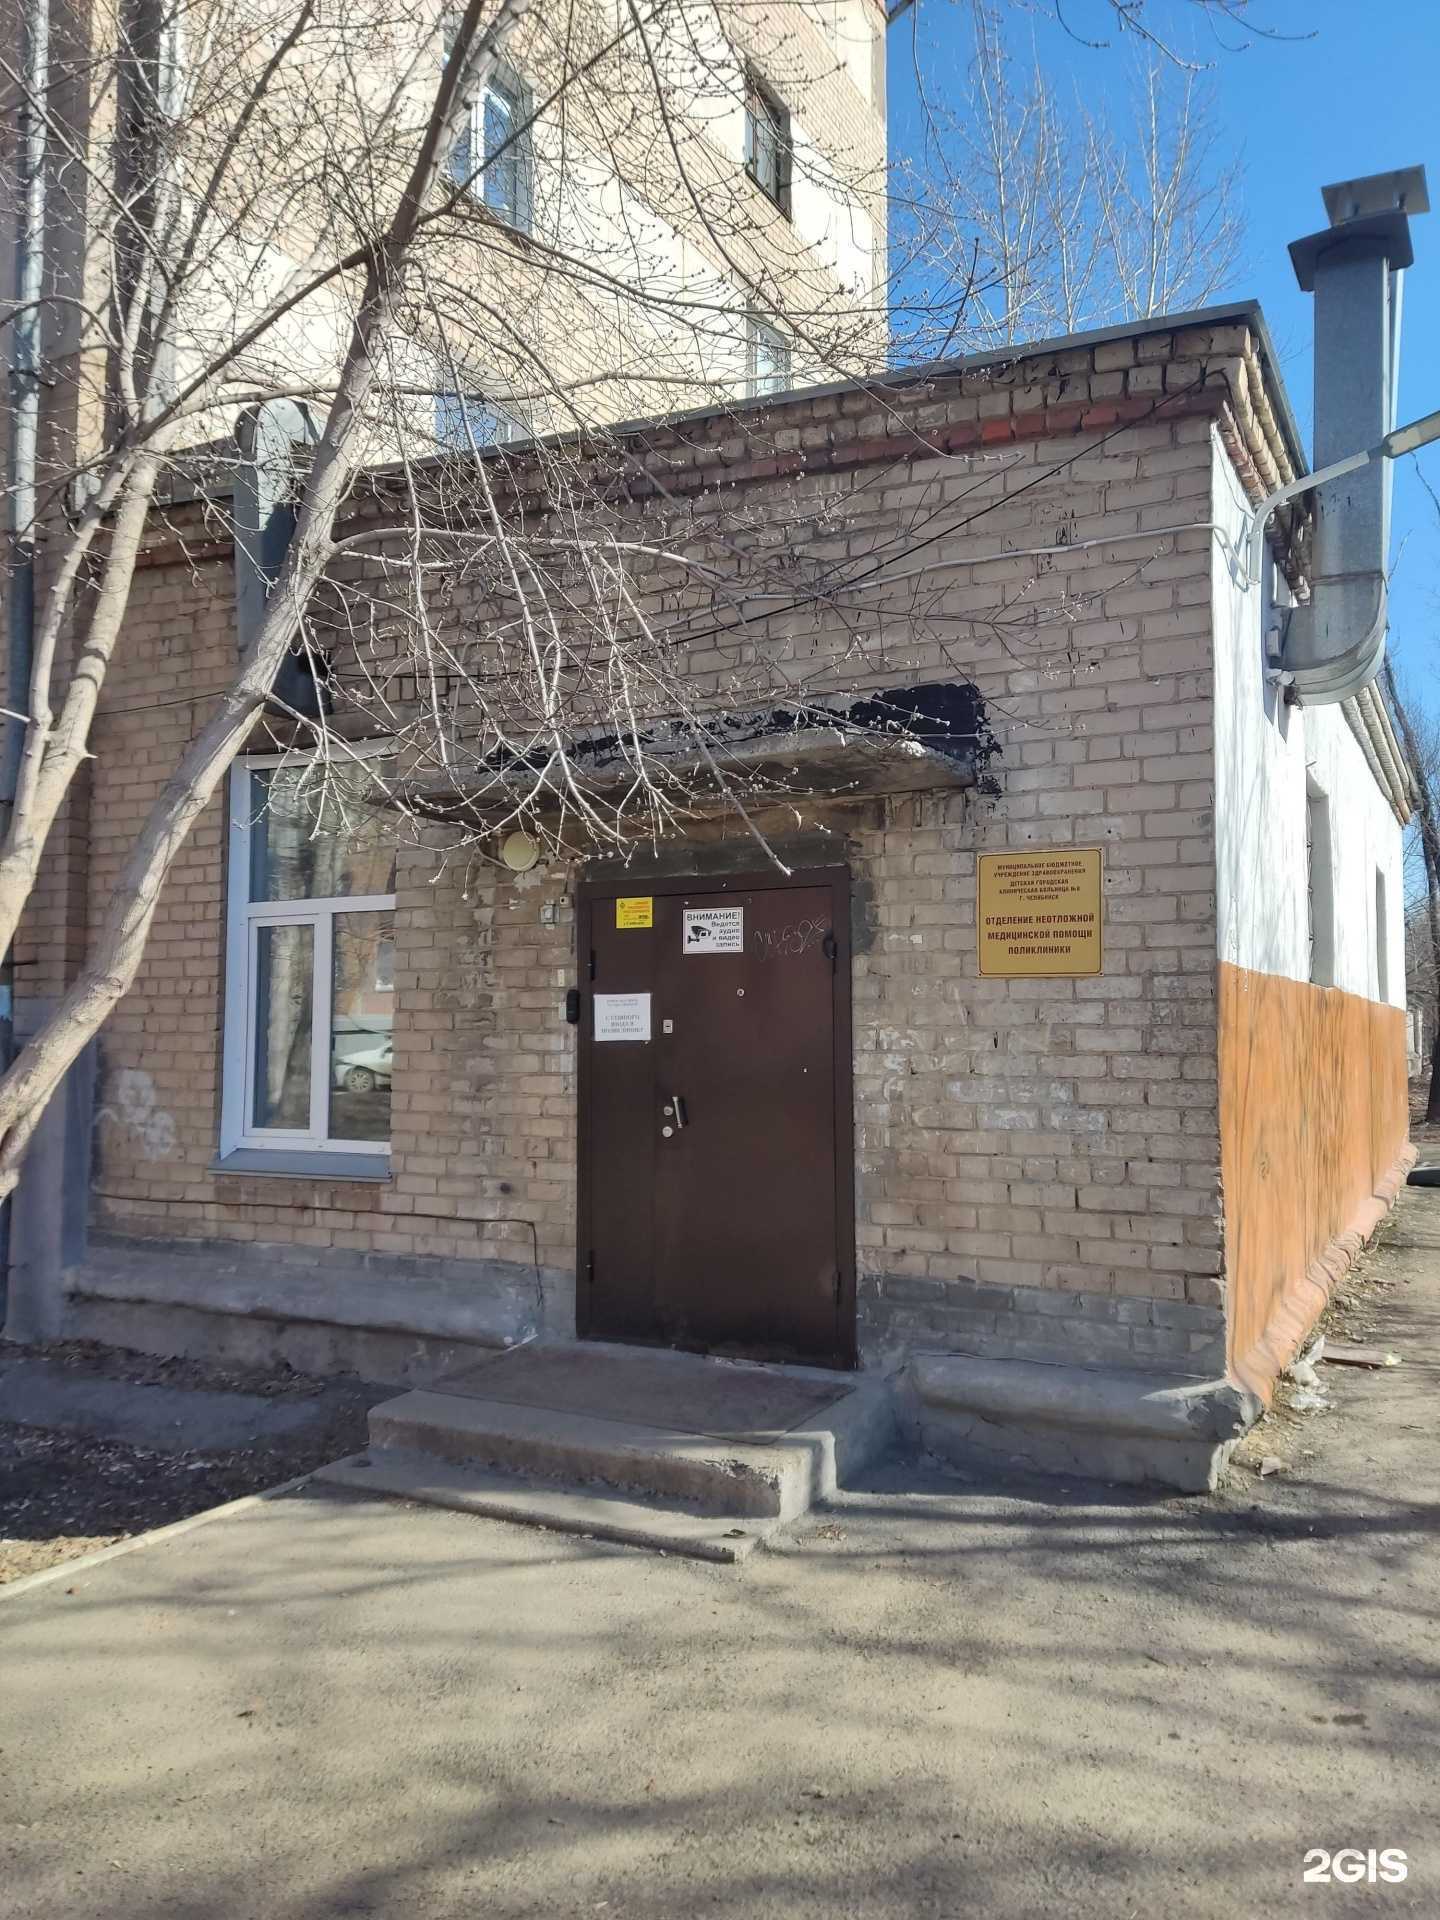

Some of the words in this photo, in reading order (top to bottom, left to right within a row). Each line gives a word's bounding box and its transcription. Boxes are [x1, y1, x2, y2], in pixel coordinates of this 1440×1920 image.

[1046, 861, 1082, 869] БЮДЖЕТНОЕ
[687, 912, 740, 921] ВНИМАНИЕ!
[985, 916, 1033, 926] ОТДЕЛЕНИЕ
[1035, 912, 1095, 924] НЕОТЛОЖНОЙ
[987, 930, 1050, 940] МЕДИЦИНСКОЙ
[1053, 929, 1093, 940] ПОМОЩИ
[1008, 946, 1071, 955] ПОЛИКЛИНИКИ
